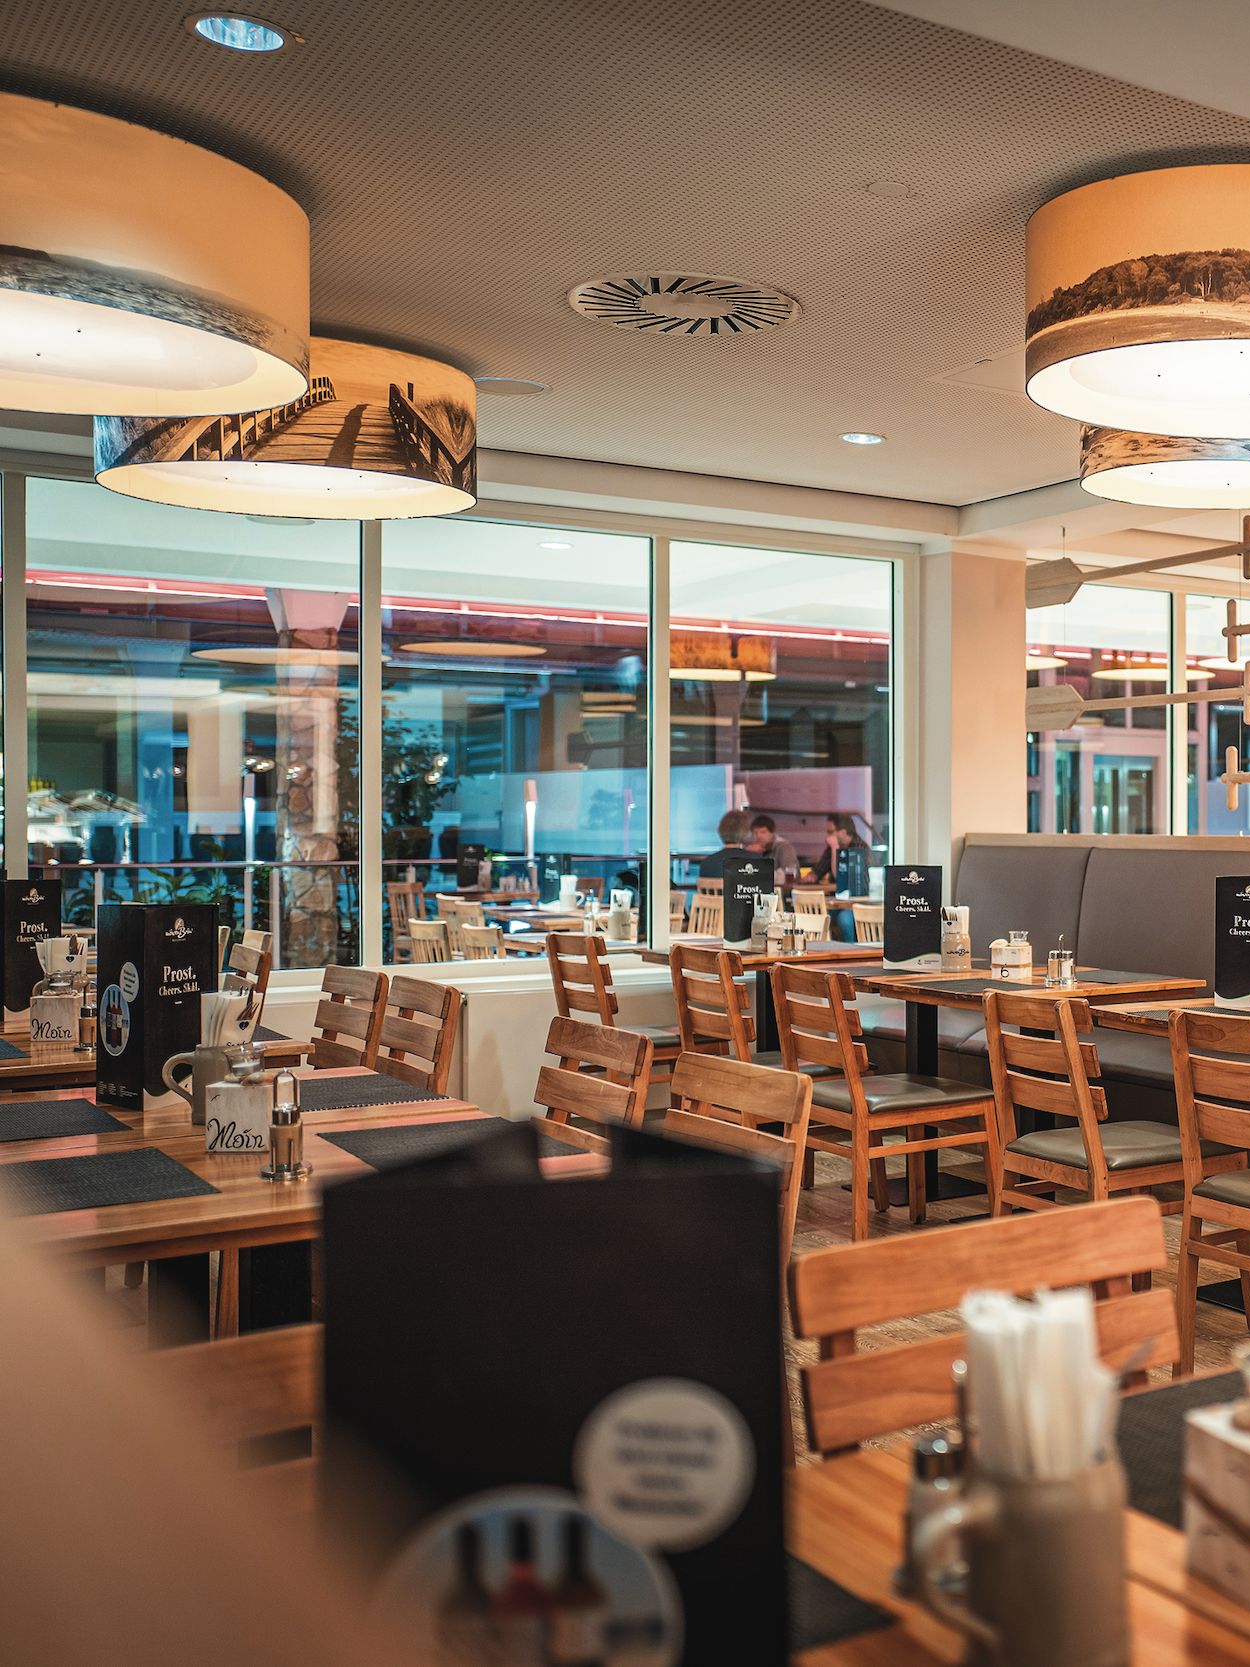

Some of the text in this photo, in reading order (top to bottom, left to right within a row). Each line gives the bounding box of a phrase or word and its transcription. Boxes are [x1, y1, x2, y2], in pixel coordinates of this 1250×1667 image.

[737, 884, 762, 893] Prost.
[899, 895, 928, 905] Prost.
[20, 921, 48, 934] Prost.
[16, 935, 36, 943] Cheers.
[163, 965, 197, 983] Prost.
[159, 986, 182, 996] Cheers.
[31, 1018, 72, 1040] Moin
[207, 1118, 265, 1150] Moin
